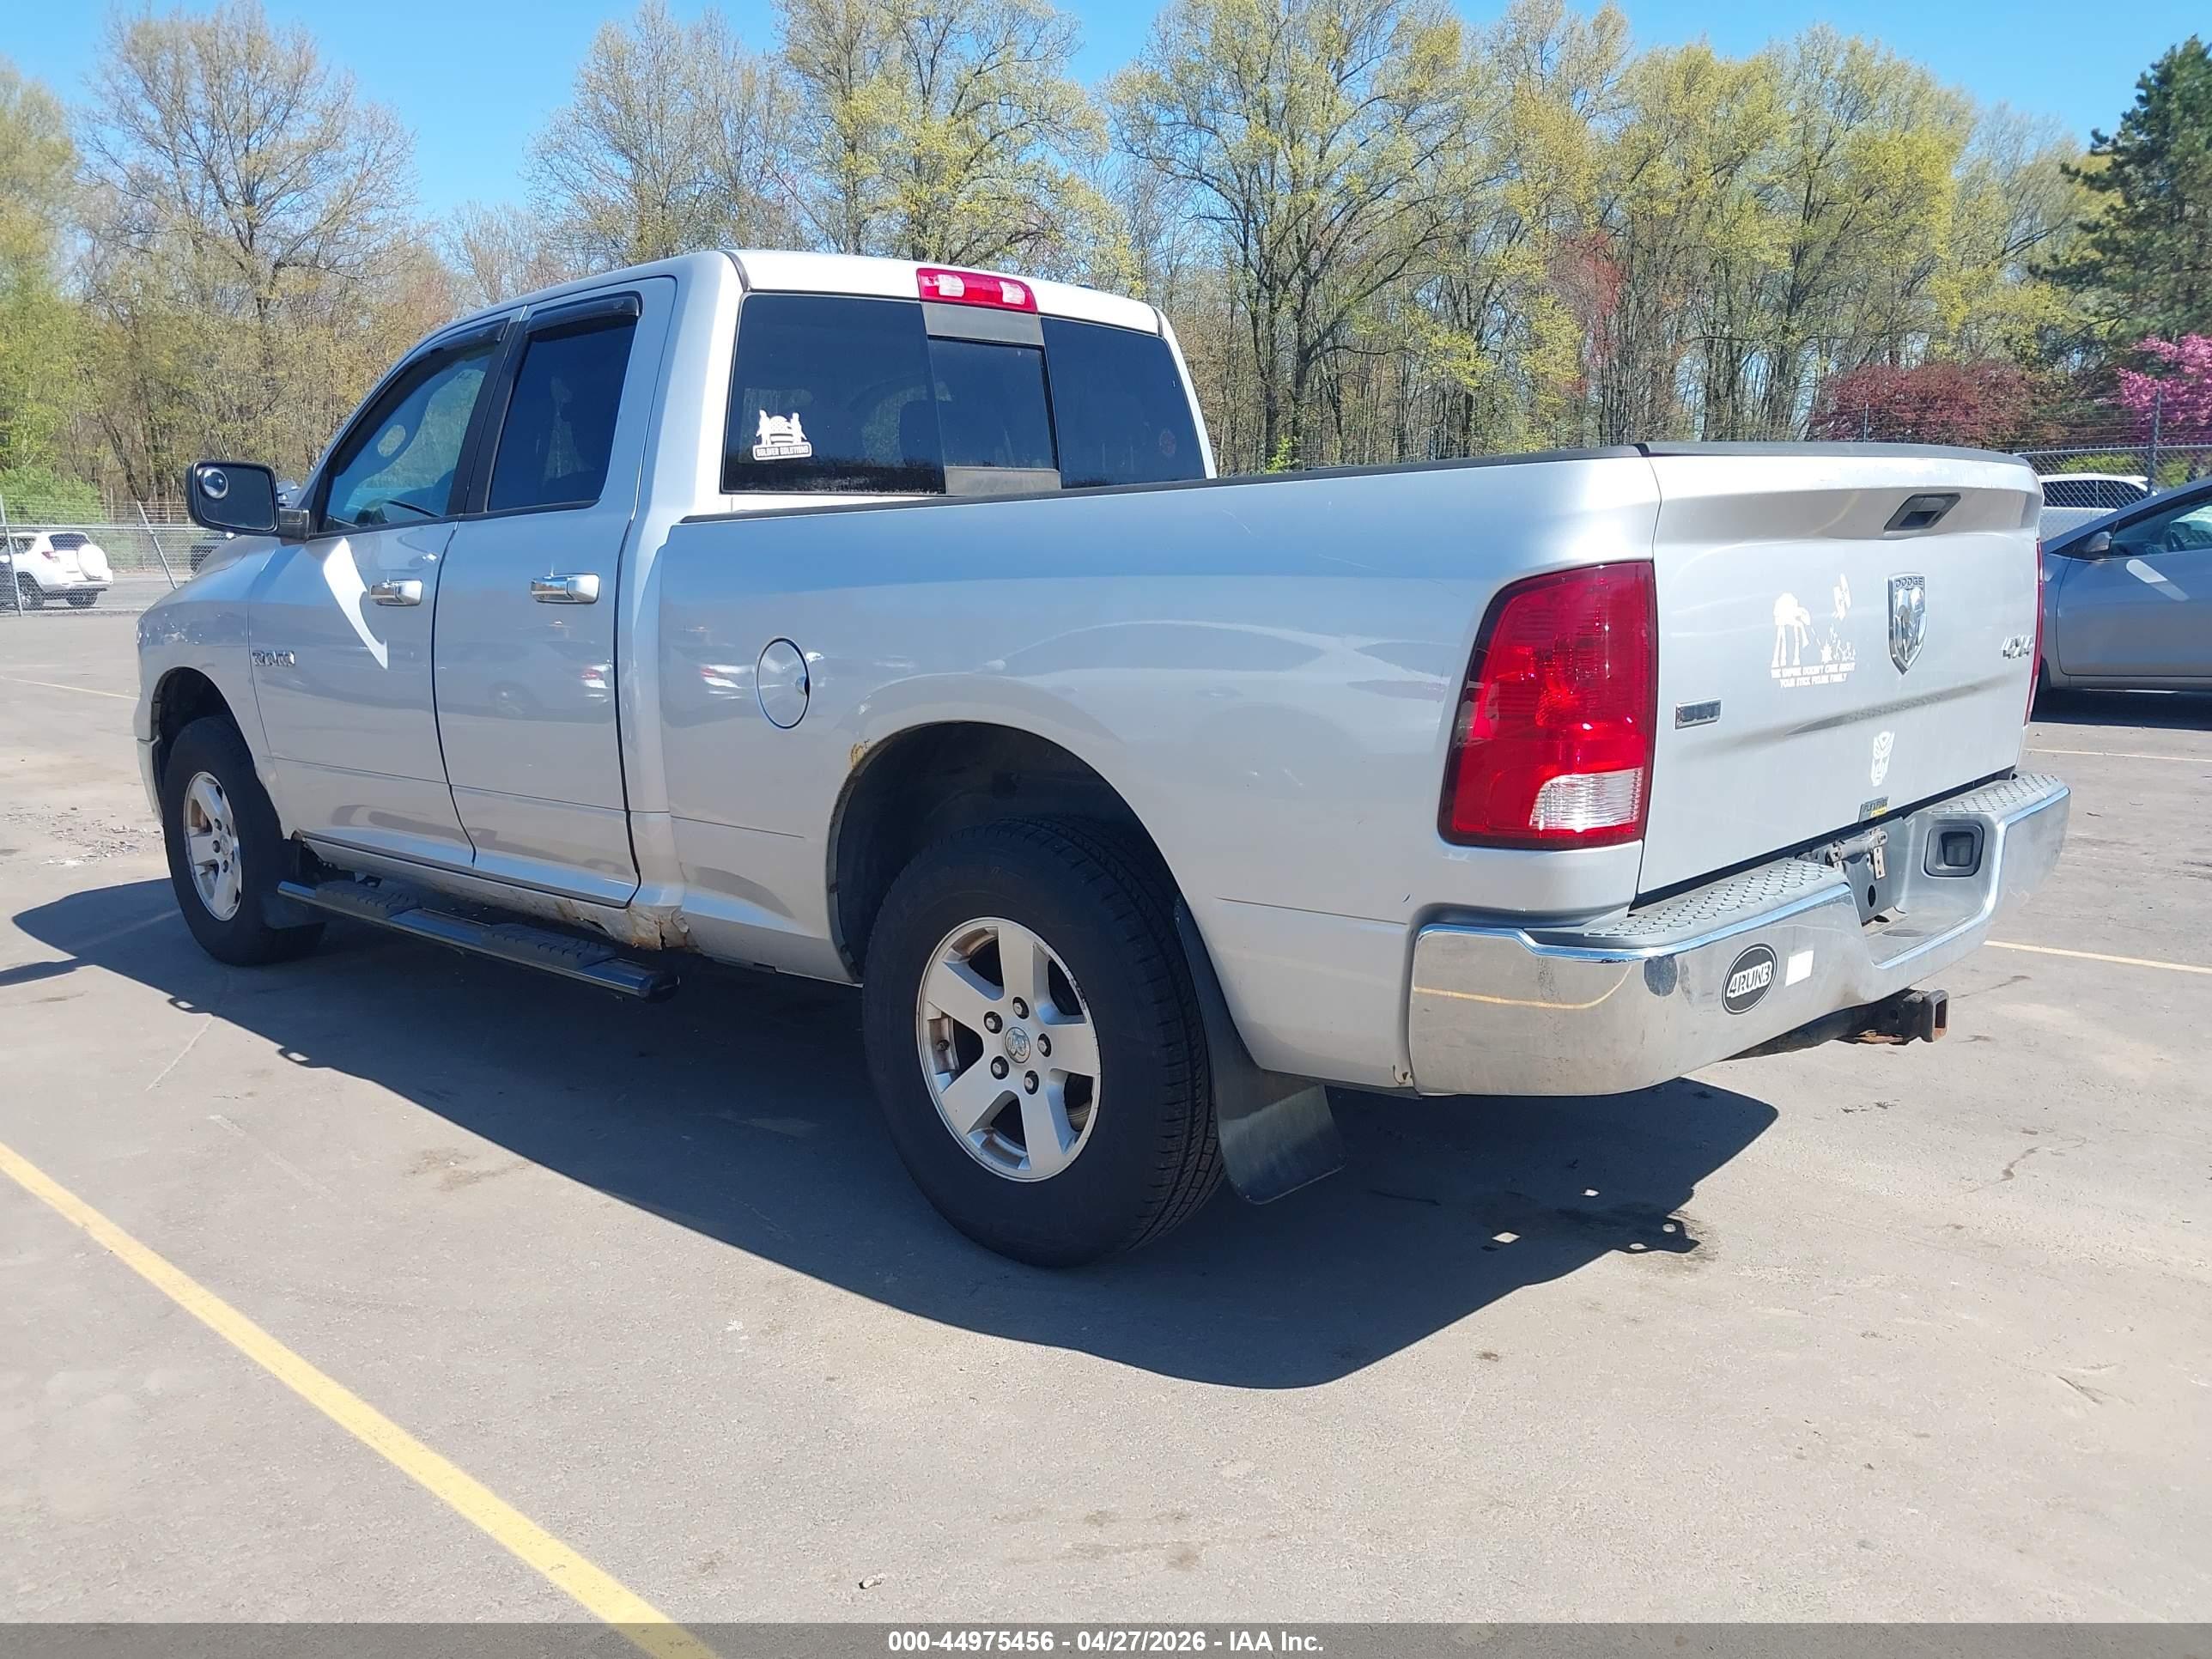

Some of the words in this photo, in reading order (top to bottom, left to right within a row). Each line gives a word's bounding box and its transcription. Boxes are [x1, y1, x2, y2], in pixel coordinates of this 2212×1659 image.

[780, 445, 809, 455] SOLUTIONS
[1895, 576, 1923, 588] DODGE
[1727, 961, 1773, 998] 4RUN3
